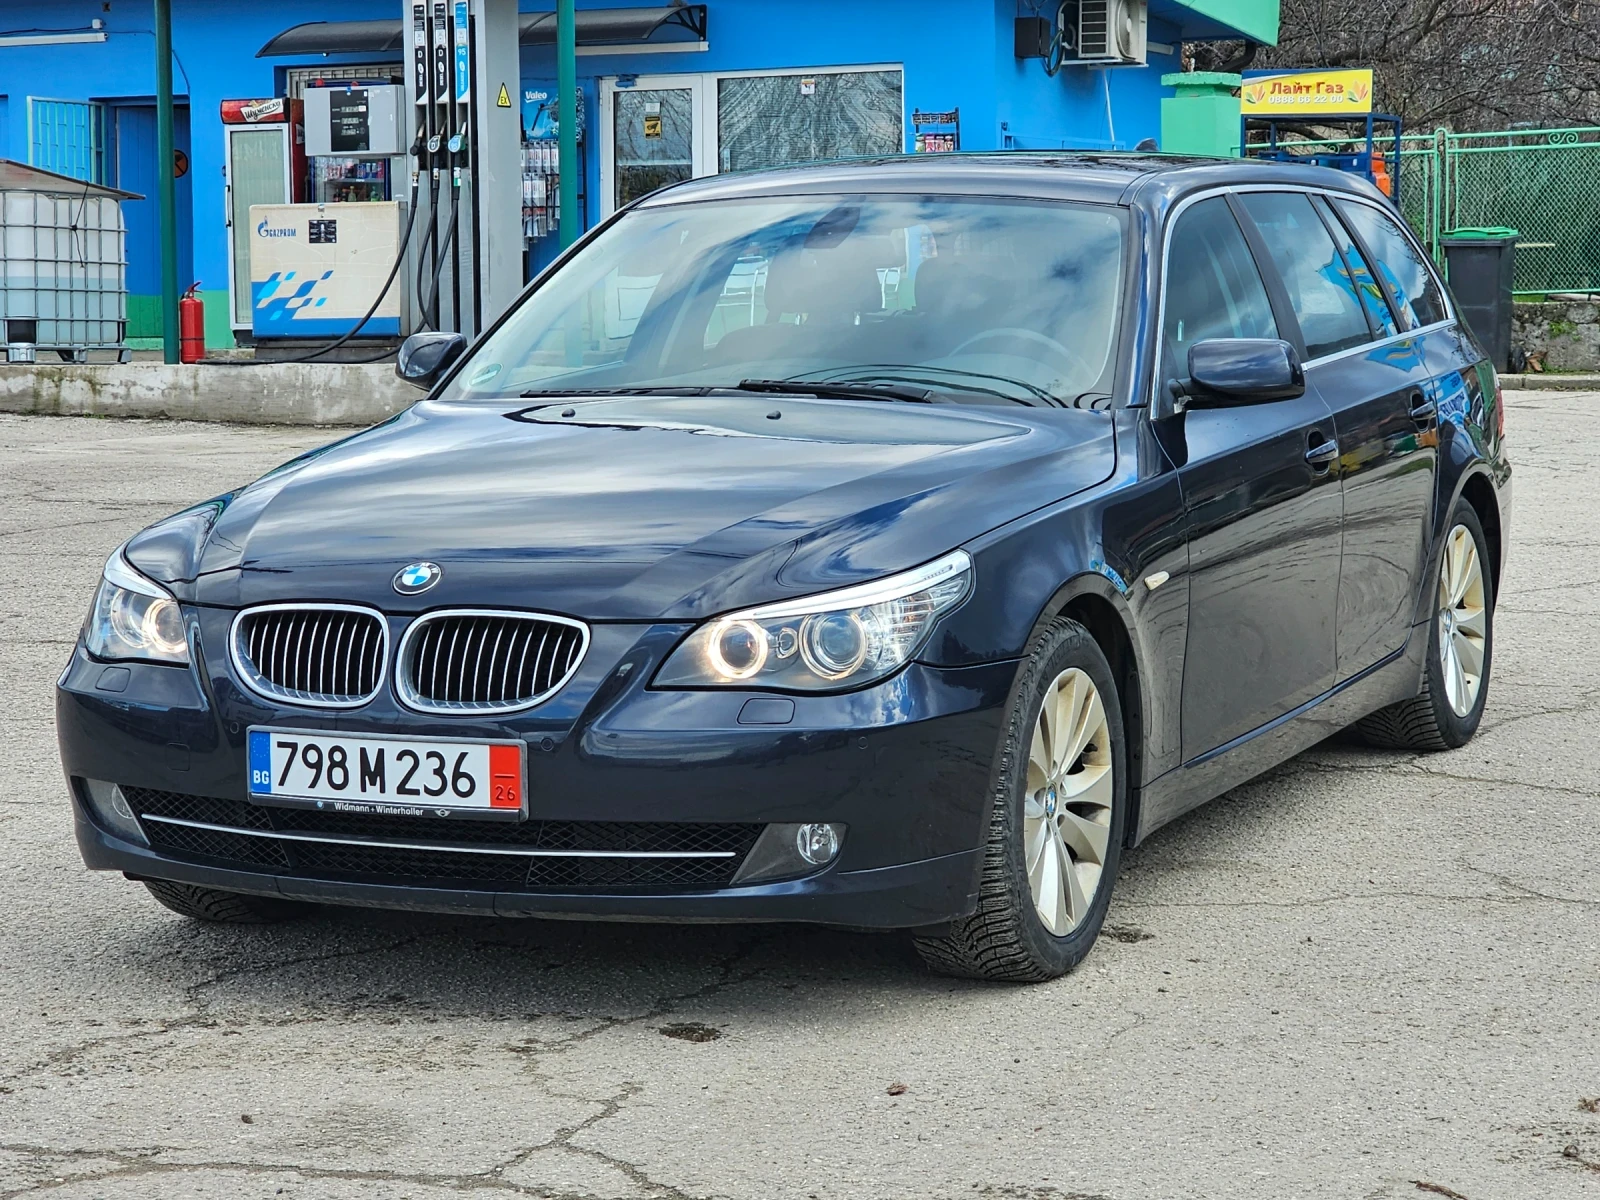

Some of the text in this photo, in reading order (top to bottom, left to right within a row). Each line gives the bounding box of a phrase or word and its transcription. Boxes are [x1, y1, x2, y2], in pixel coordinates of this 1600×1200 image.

[418, 50, 422, 58] D
[438, 49, 443, 57] D
[458, 48, 466, 56] 95
[1270, 82, 1344, 94] Лайт Газ
[500, 96, 508, 104] EX
[525, 91, 548, 100] Valeo
[1268, 94, 1344, 104] 0888 66 22 00
[269, 228, 297, 238] GAZPROM
[253, 770, 270, 784] BG
[495, 785, 516, 801] 26
[334, 802, 370, 812] Widmann
[376, 805, 424, 816] Winterholler
